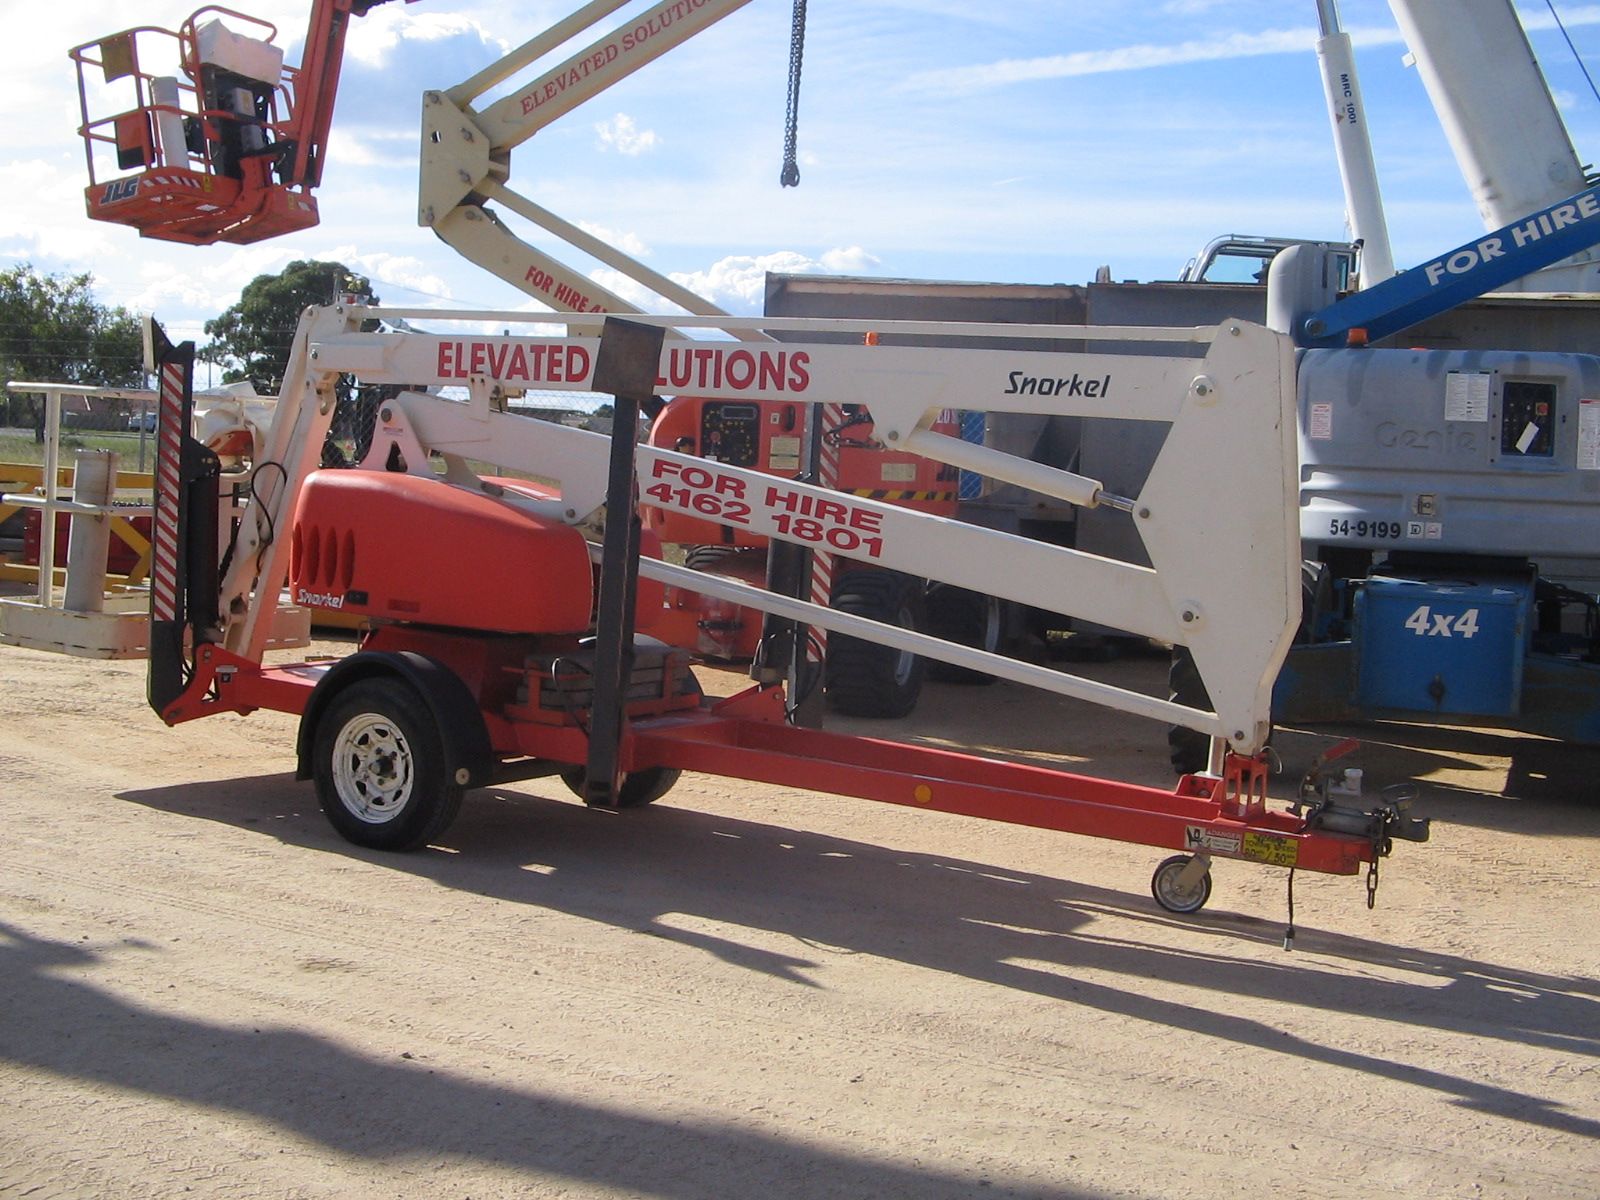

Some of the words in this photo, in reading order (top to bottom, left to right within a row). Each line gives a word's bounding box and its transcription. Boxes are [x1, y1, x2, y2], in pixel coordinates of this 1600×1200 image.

[520, 43, 619, 116] ELEVATED
[621, 0, 711, 51] SOLUTIO
[1340, 73, 1352, 98] MRC
[1346, 103, 1357, 125] 100t
[101, 178, 138, 204] JLG
[1424, 237, 1506, 287] FOR
[1511, 193, 1600, 248] HIRE
[524, 265, 554, 293] FOR
[554, 283, 589, 313] HIRE
[437, 341, 590, 383] ELEVATED
[653, 347, 811, 393] LUTIONS
[1004, 371, 1111, 398] Snorkel
[646, 482, 751, 525] 4162
[771, 513, 883, 559] 1801
[651, 458, 747, 499] FOR
[764, 486, 884, 534] HIRE
[1329, 518, 1402, 539] 54-9199
[297, 589, 345, 609] Snorkel
[1404, 605, 1480, 639] 4x4
